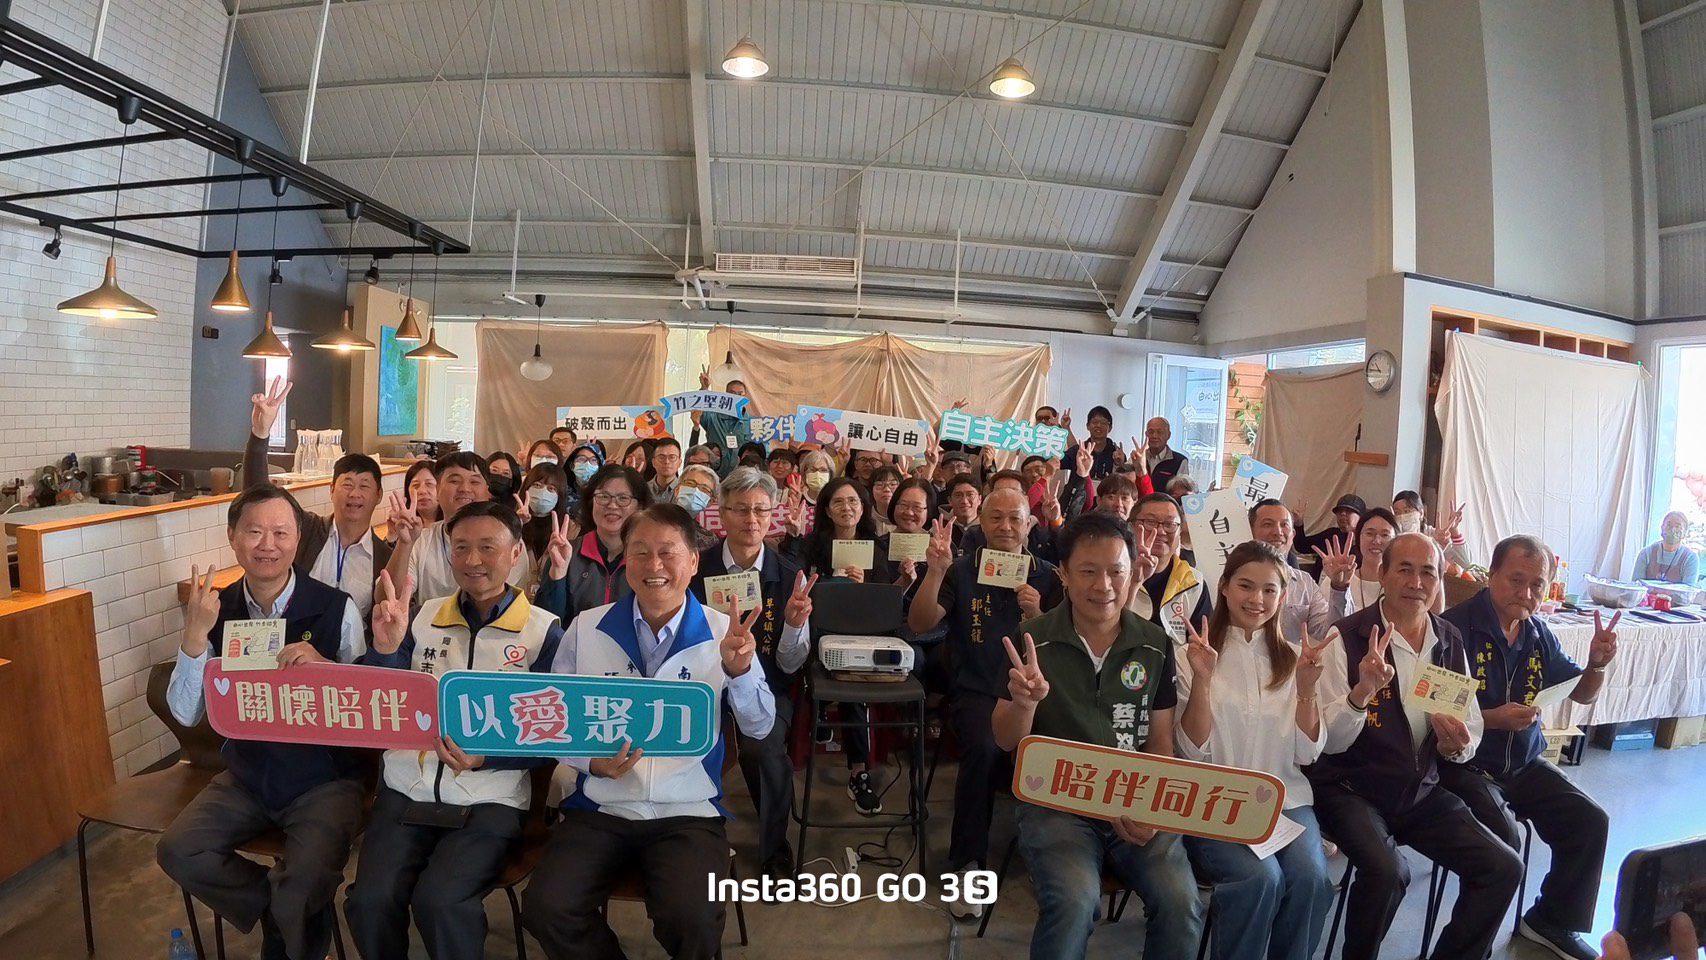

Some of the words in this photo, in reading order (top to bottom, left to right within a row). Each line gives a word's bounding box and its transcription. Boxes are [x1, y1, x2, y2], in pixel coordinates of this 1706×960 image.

[565, 416, 627, 431] 破殼而出
[749, 415, 796, 443] 夥伴
[847, 422, 919, 447] 讓心自由
[942, 410, 1067, 458] 自主決策
[761, 597, 775, 656] 草屯鎮公所
[970, 597, 984, 643] 郭玉龍
[235, 680, 409, 732] 關懷陪伴
[457, 685, 692, 746] 以愛聚力
[1049, 758, 1251, 826] 陪伴同行
